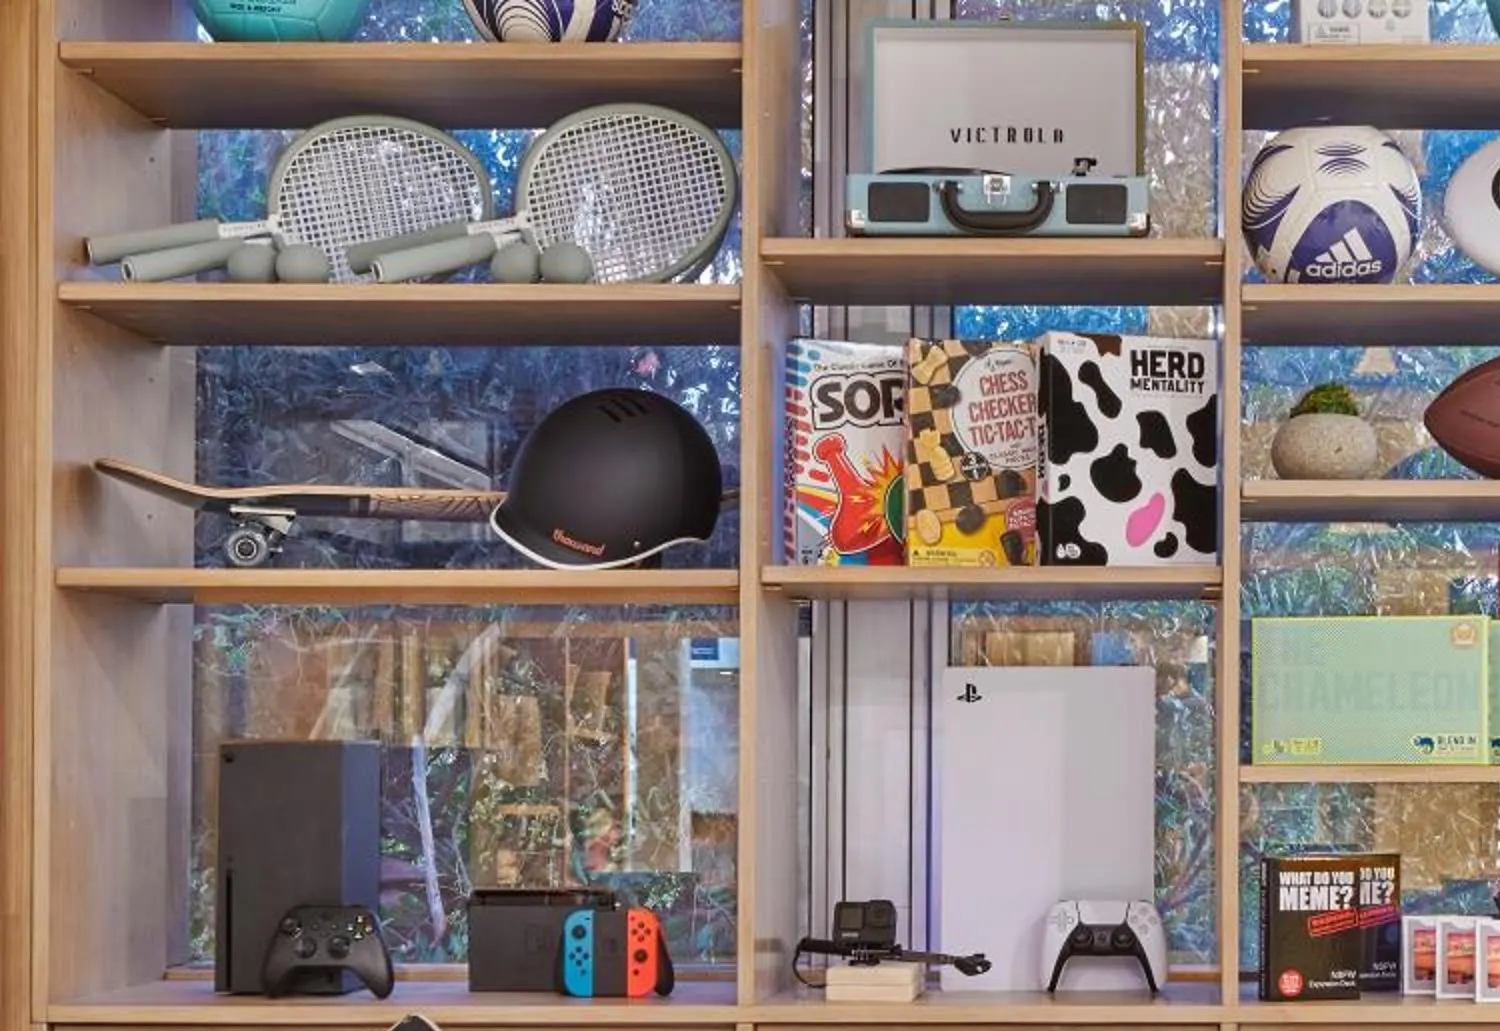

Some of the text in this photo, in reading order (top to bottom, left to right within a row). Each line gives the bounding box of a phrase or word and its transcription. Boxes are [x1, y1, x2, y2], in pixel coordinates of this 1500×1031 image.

[950, 127, 1063, 144] VICTROLA
[1306, 260, 1382, 278] adidas
[1130, 350, 1205, 379] HERD
[980, 369, 1029, 397] CHESS
[1130, 378, 1205, 395] MENTALITY
[1259, 670, 1479, 712] CHAMELEON
[1280, 871, 1355, 886] WHAT DO YOU
[1280, 885, 1354, 911] MEME?
